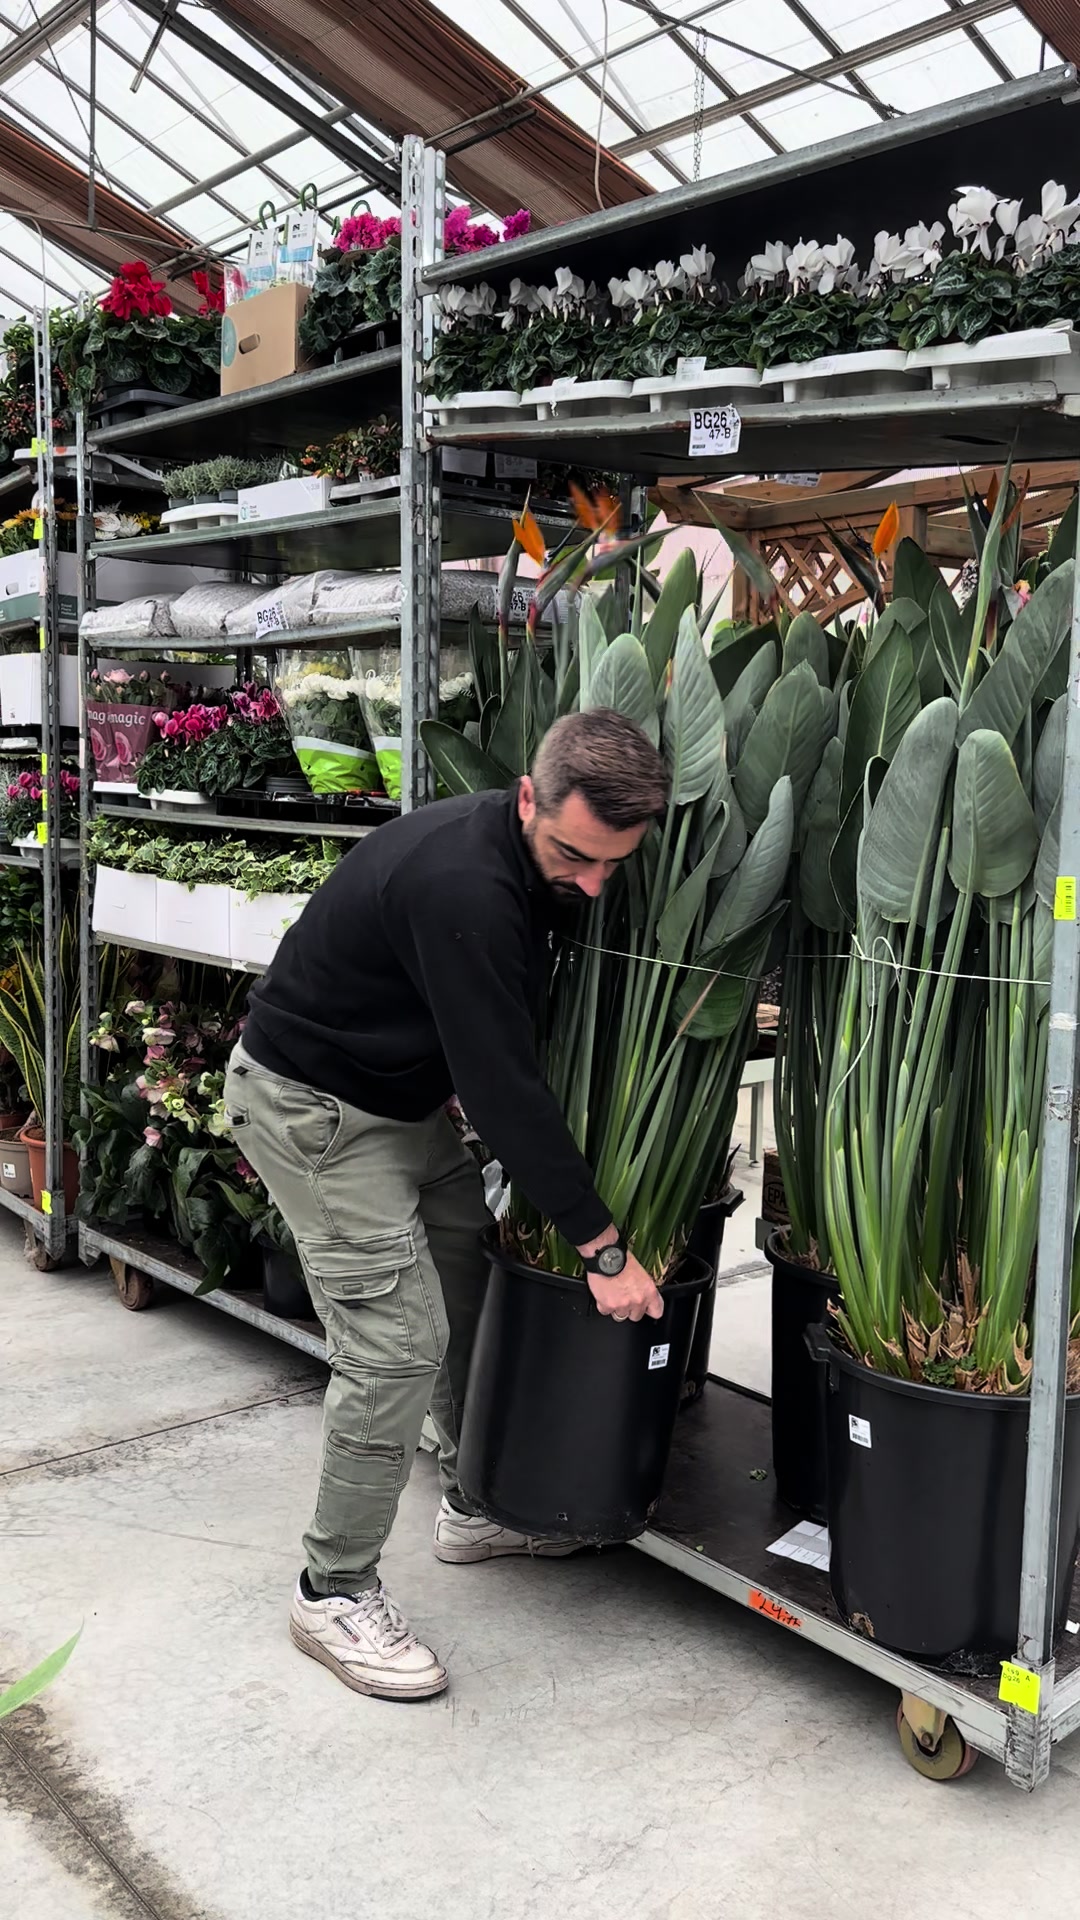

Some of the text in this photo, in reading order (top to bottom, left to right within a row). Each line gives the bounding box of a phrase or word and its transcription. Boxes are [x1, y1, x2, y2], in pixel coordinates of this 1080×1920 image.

[694, 411, 727, 429] BG26
[709, 428, 731, 440] 47-B
[107, 711, 146, 727] magic
